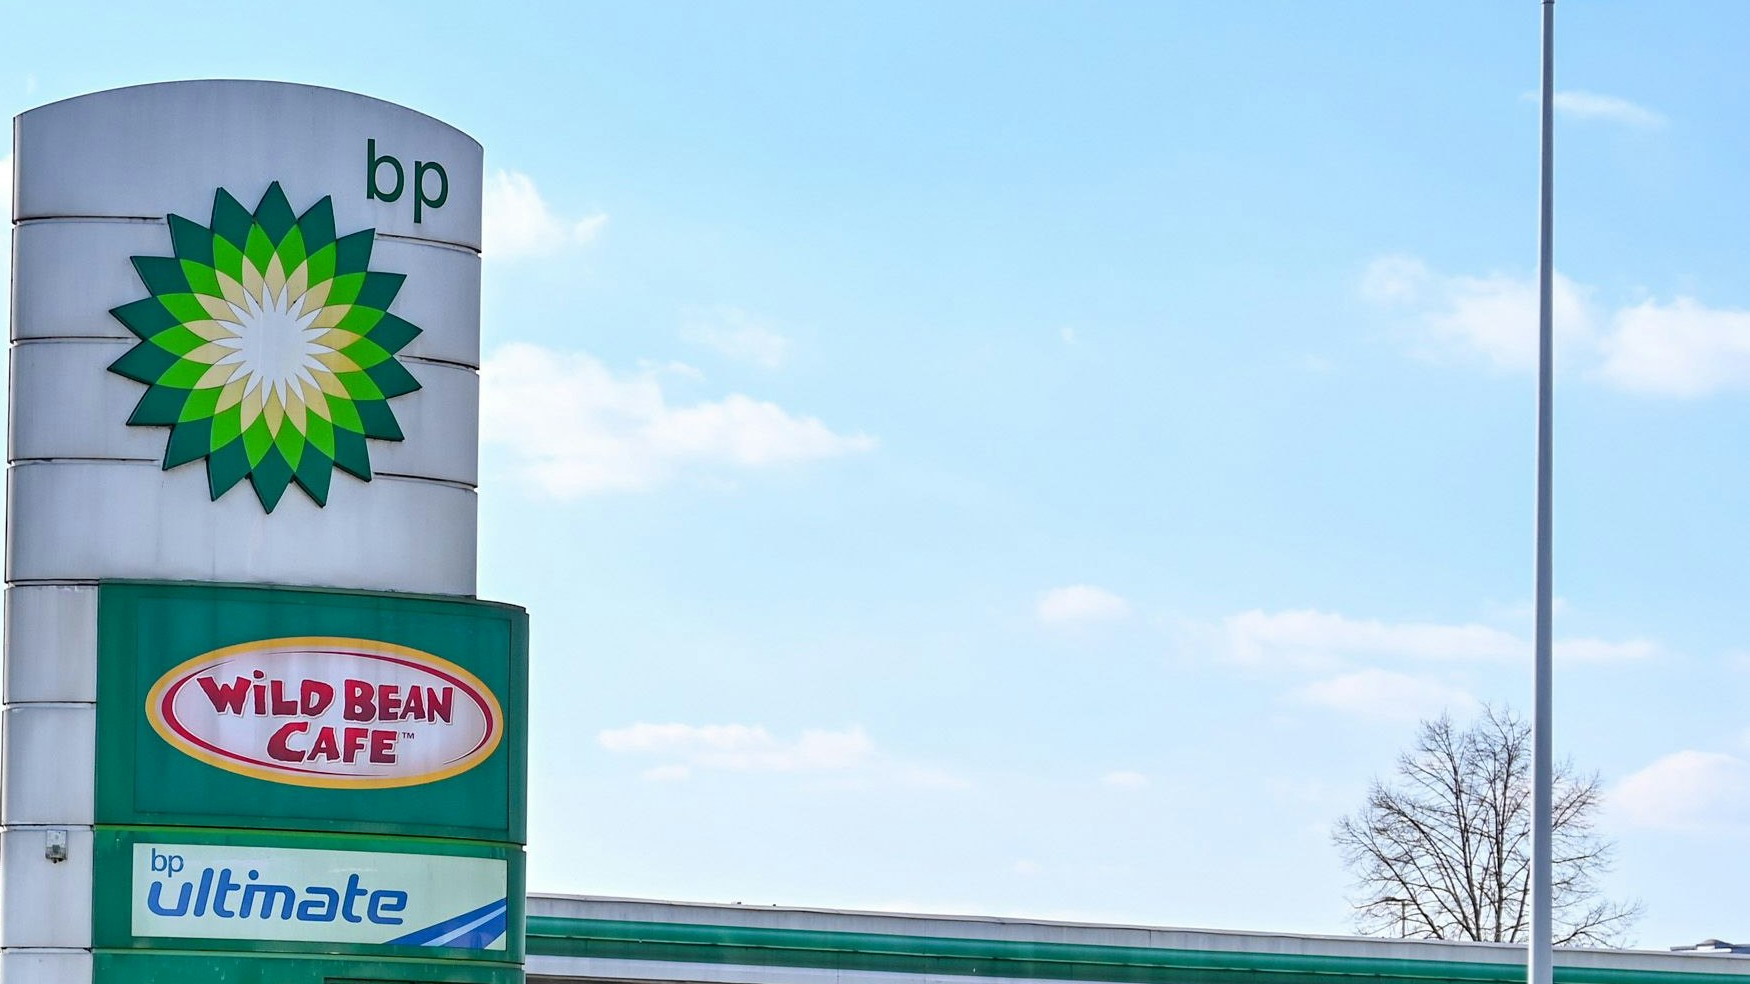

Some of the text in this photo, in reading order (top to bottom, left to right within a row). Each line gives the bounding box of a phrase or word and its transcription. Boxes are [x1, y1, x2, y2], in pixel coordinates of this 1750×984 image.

[366, 138, 449, 224] bp
[343, 679, 453, 723] BEAN
[151, 848, 184, 878] bp
[147, 867, 408, 926] ultimate
